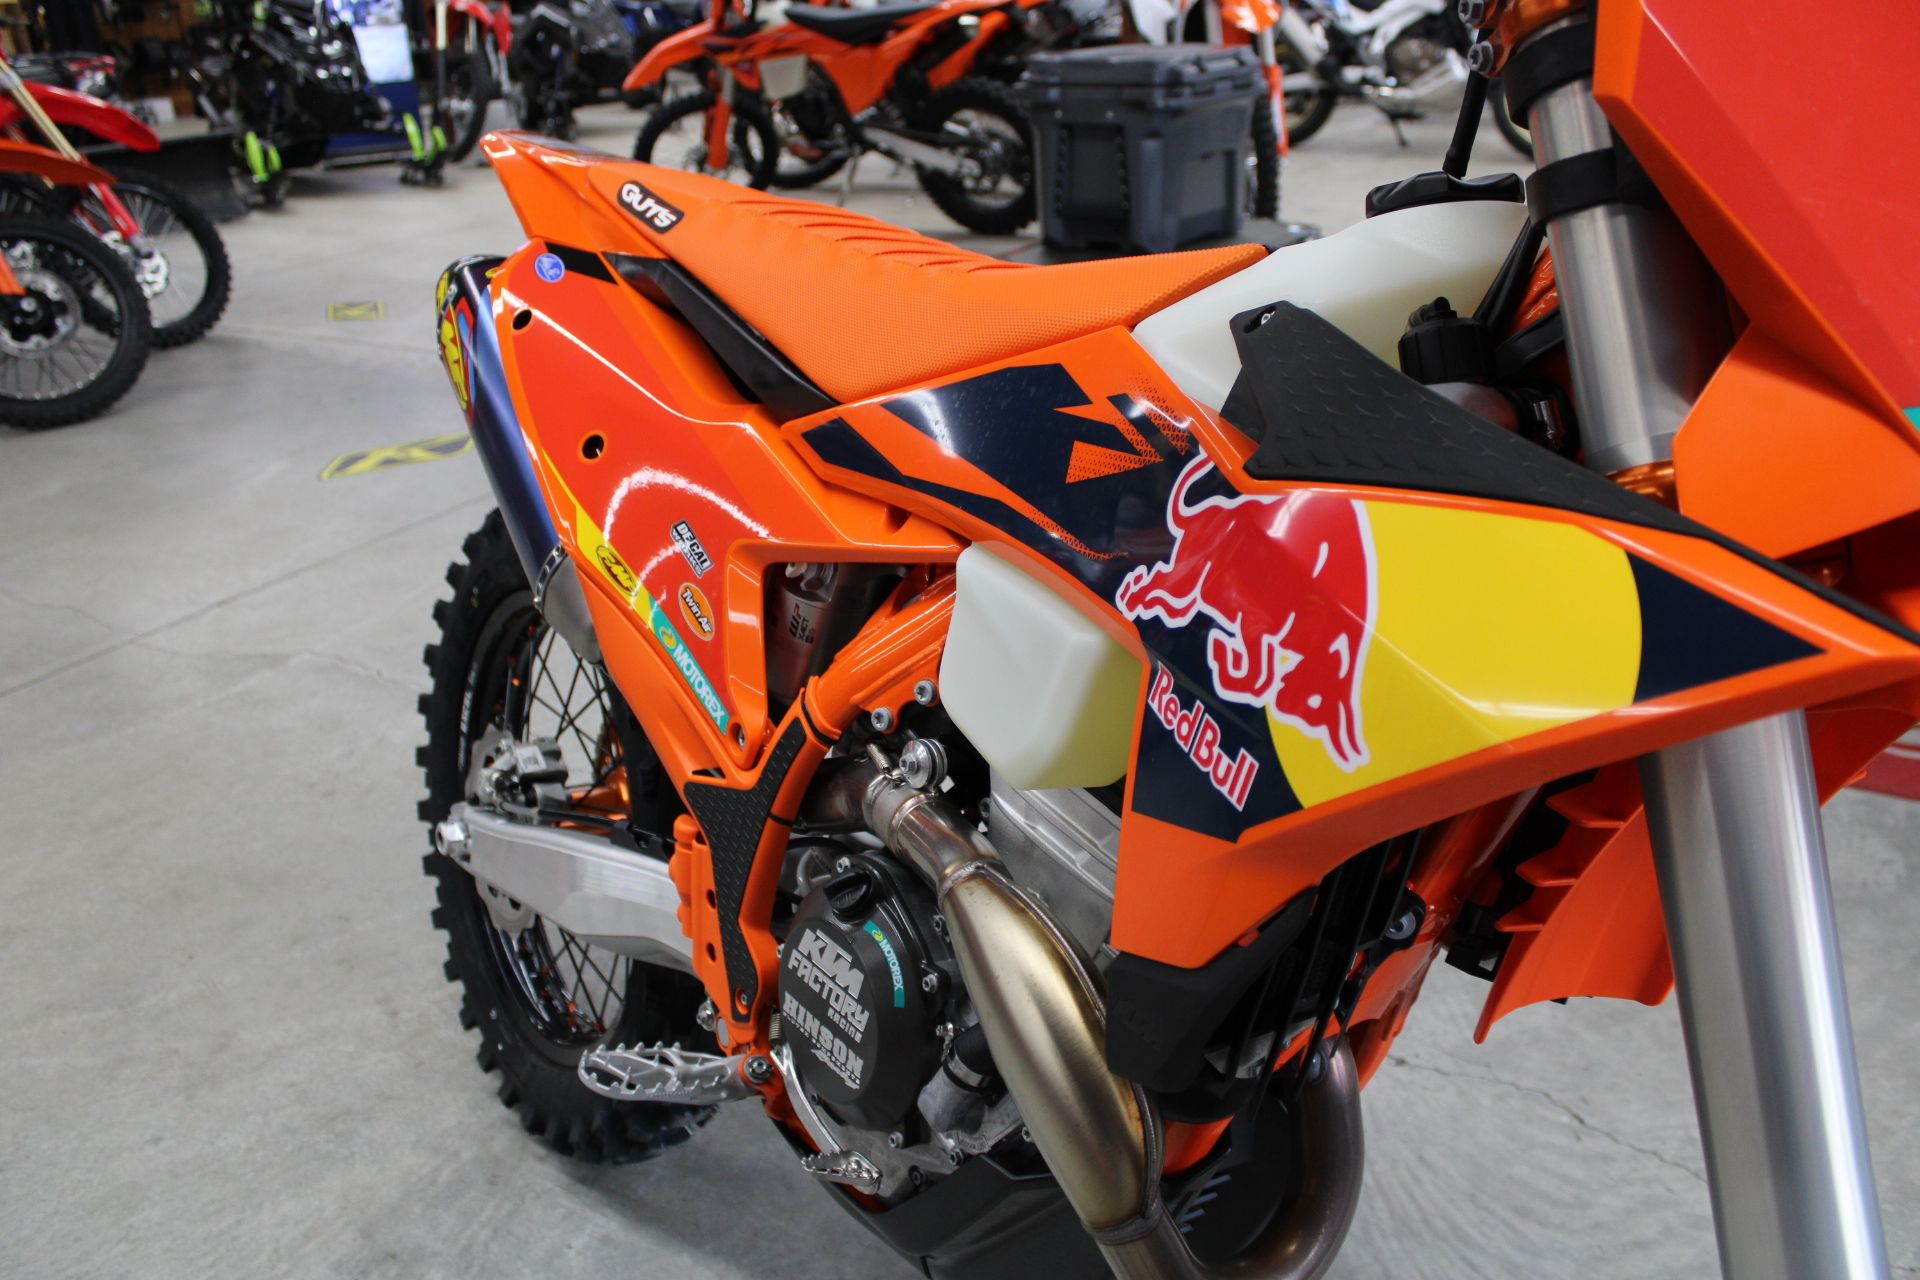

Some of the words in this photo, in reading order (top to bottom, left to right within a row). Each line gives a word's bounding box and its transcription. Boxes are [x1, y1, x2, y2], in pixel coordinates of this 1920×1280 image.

[622, 184, 677, 228] GUTS
[682, 588, 701, 618] Twin
[698, 615, 712, 633] Air
[673, 644, 725, 726] MOTOREX
[1148, 661, 1204, 753] Red
[1190, 713, 1260, 812] Bull
[788, 949, 870, 1033] FACTORY
[798, 928, 864, 1000] KTM
[880, 940, 904, 991] MOTOREX
[783, 991, 864, 1076] HINSON
